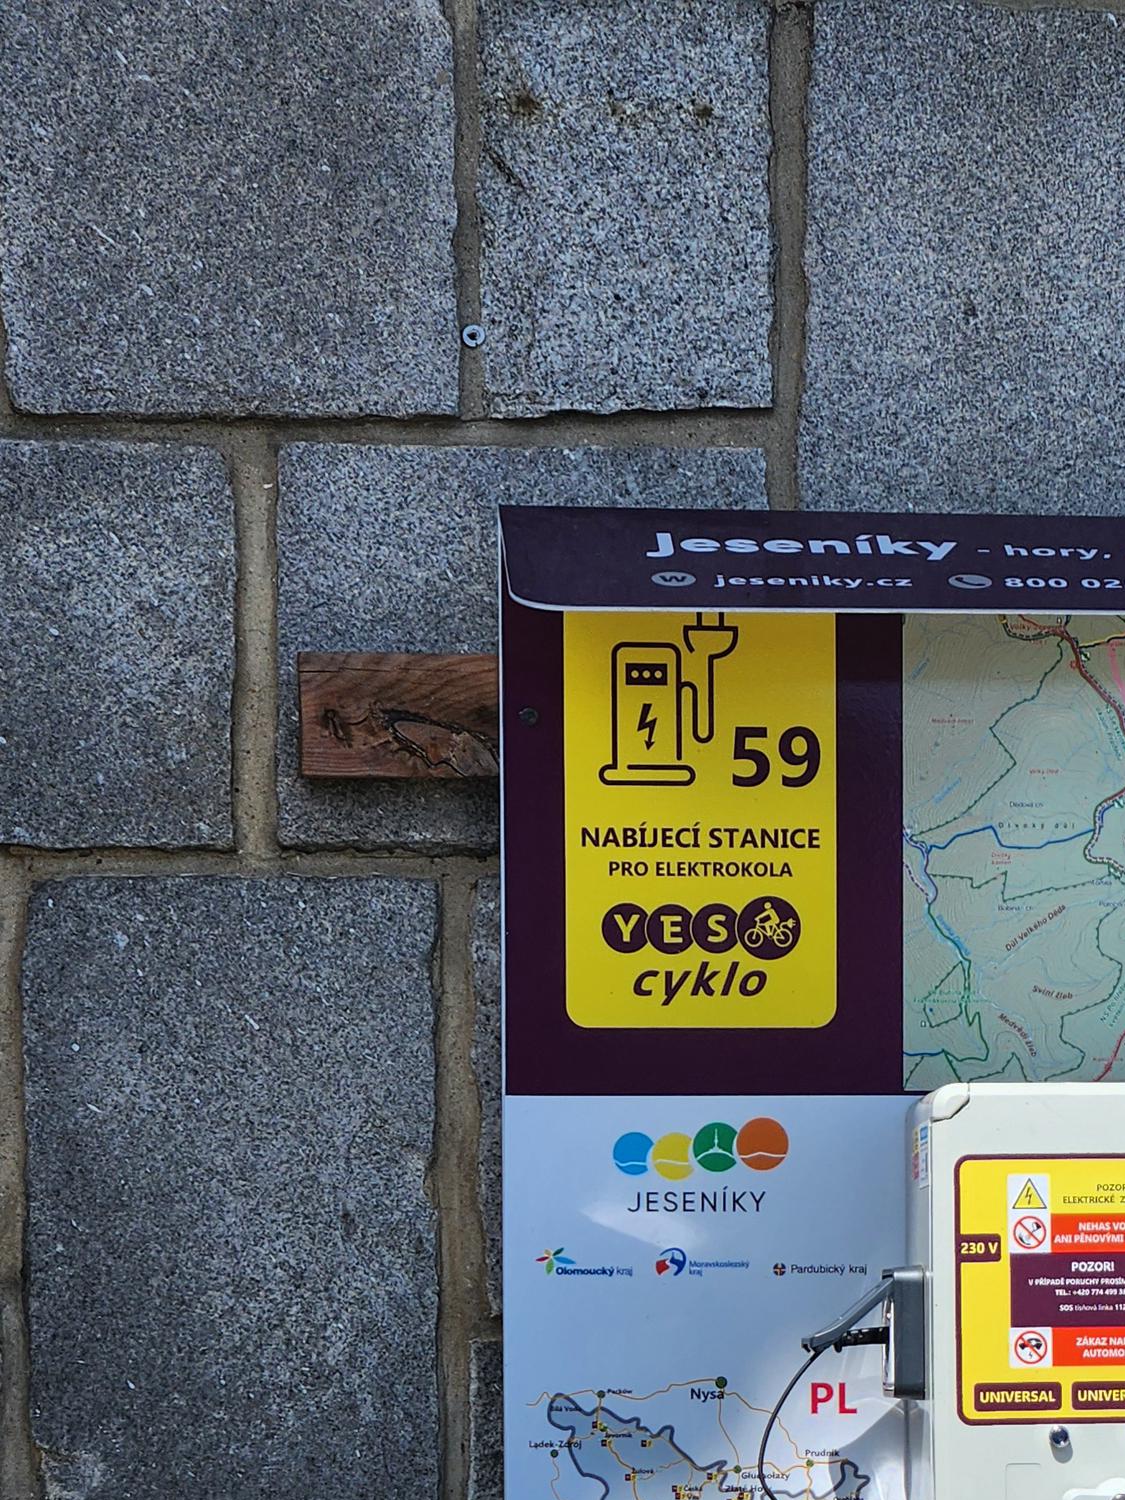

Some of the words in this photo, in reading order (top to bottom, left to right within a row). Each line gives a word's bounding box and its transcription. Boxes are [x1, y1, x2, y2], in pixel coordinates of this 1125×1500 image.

[646, 532, 957, 561] Jeseníky
[1003, 544, 1111, 560] hory,
[714, 573, 913, 589] jeseniky.cz
[1004, 577, 1069, 589] 800
[732, 725, 821, 788] 59
[580, 822, 700, 848] NABÍJECÍ
[708, 828, 821, 849] STANICE
[608, 861, 649, 877] PRO
[655, 862, 793, 878] ELEKTROKOLA
[613, 913, 730, 944] YES
[632, 961, 768, 1006] cyklo
[626, 1186, 767, 1213] JESENÍKY
[1062, 1194, 1115, 1204] ELEKTRICKÉ
[1078, 1222, 1111, 1232] NEHAS
[1053, 1234, 1073, 1244] ANI
[1074, 1232, 1124, 1244] PĚNOVÝMI
[960, 1242, 986, 1254] 230
[986, 1242, 999, 1254] V
[555, 1266, 616, 1279] Olomoucký
[616, 1266, 634, 1279] kraj
[790, 1264, 846, 1276] Pardubický
[848, 1264, 868, 1276] kraj
[1070, 1261, 1115, 1272] POZOR!
[1028, 1278, 1034, 1286] V
[1066, 1278, 1100, 1286] PORUCHY
[1091, 1288, 1104, 1296] 774
[1059, 1304, 1074, 1312] SOS
[1076, 1336, 1108, 1348] ZÁKAZ
[690, 1388, 726, 1403] Nysa
[810, 1382, 858, 1416] PL
[979, 1390, 1056, 1404] UNIVERSAL
